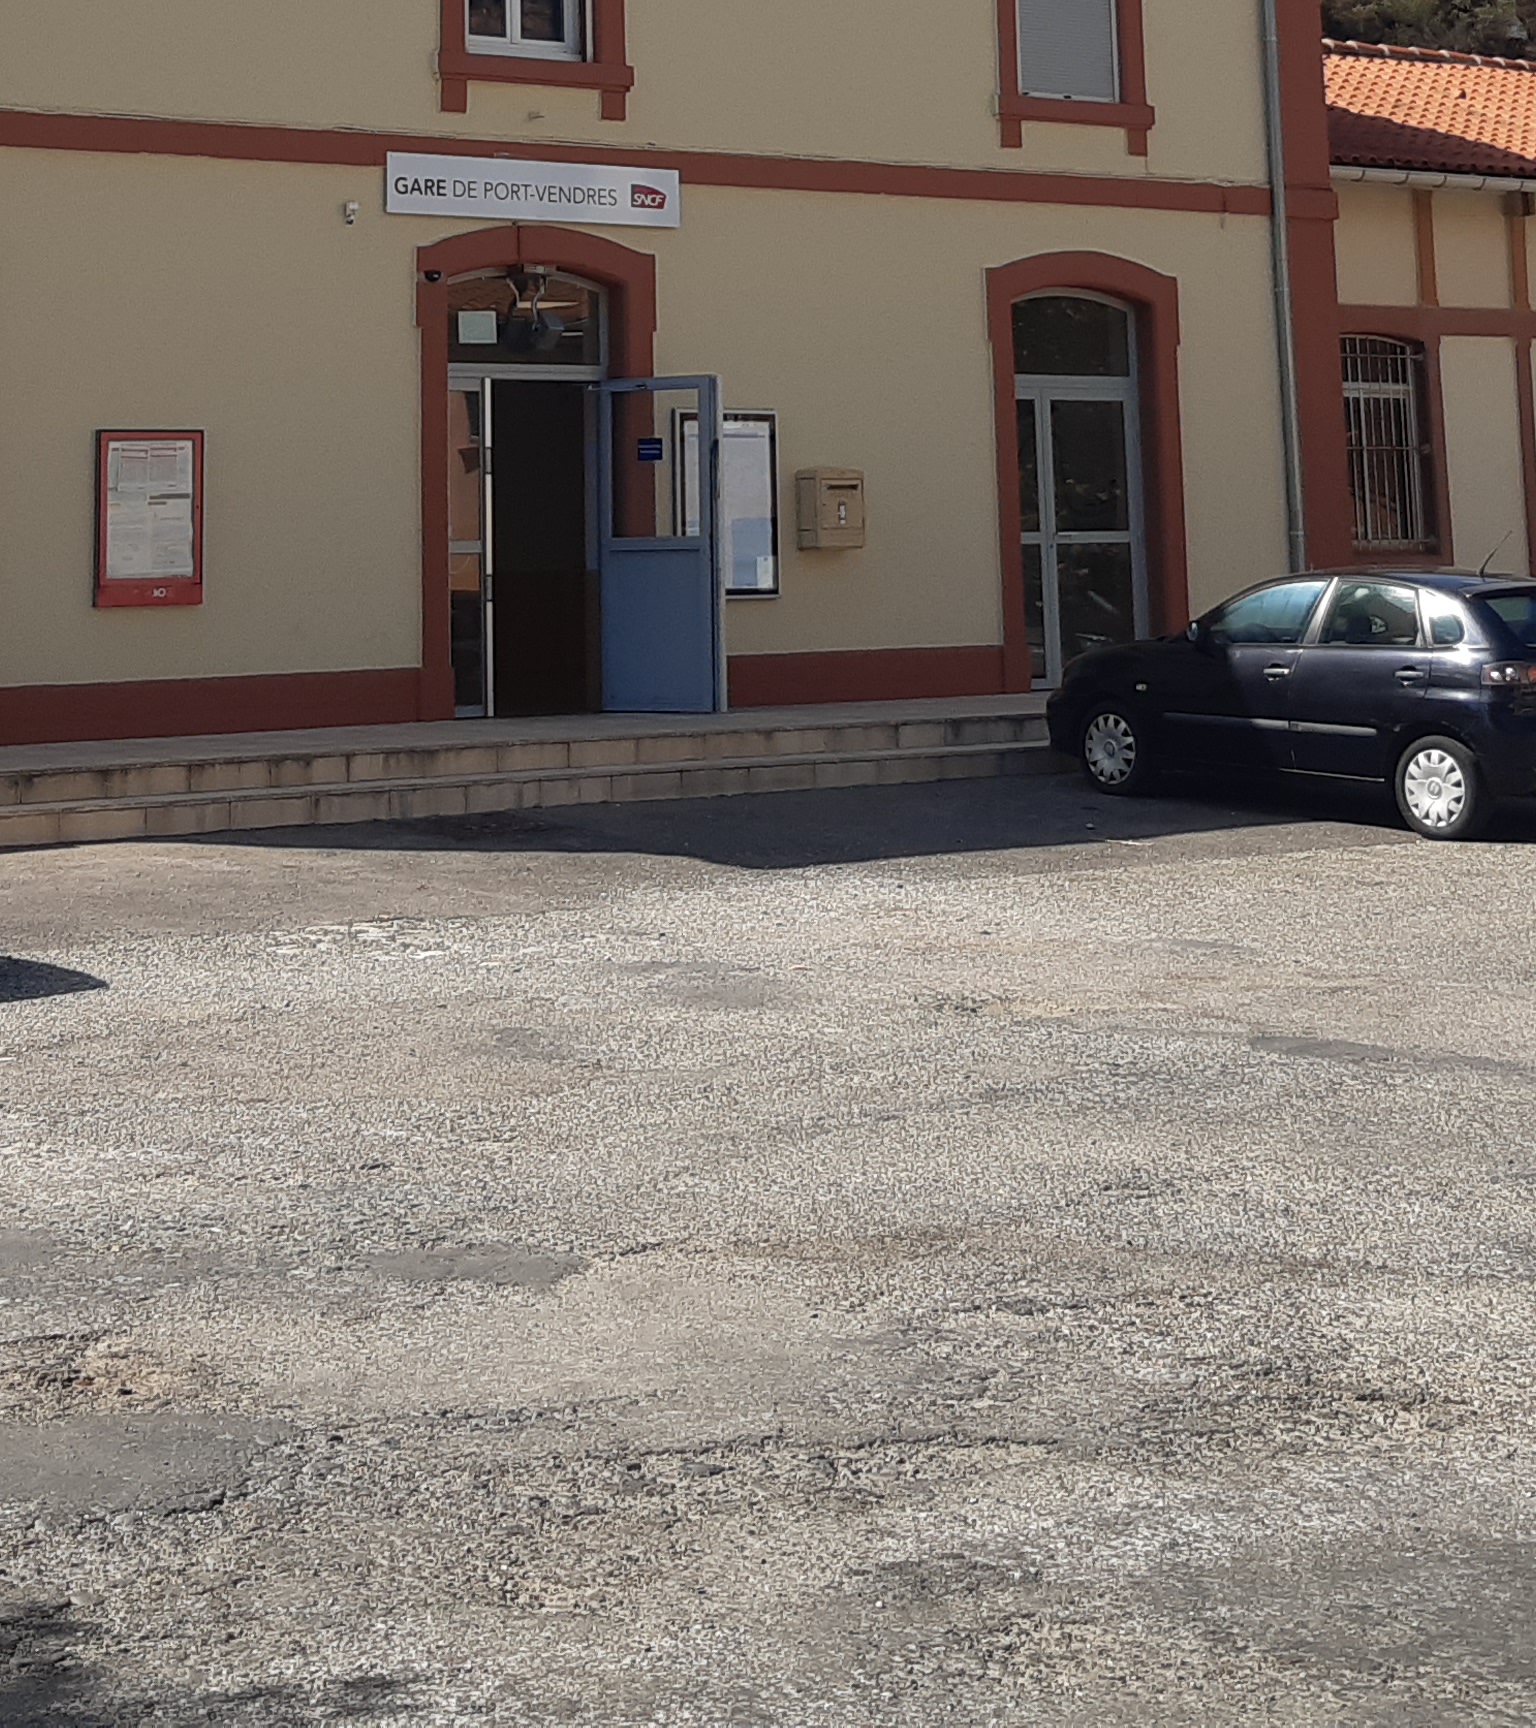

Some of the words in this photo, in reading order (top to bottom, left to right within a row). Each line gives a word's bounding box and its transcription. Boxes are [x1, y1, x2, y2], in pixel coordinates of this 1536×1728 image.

[394, 176, 447, 197] GARE
[452, 180, 478, 199] DE
[483, 181, 618, 206] PORT-VENDRES
[632, 191, 665, 207] SNCF
